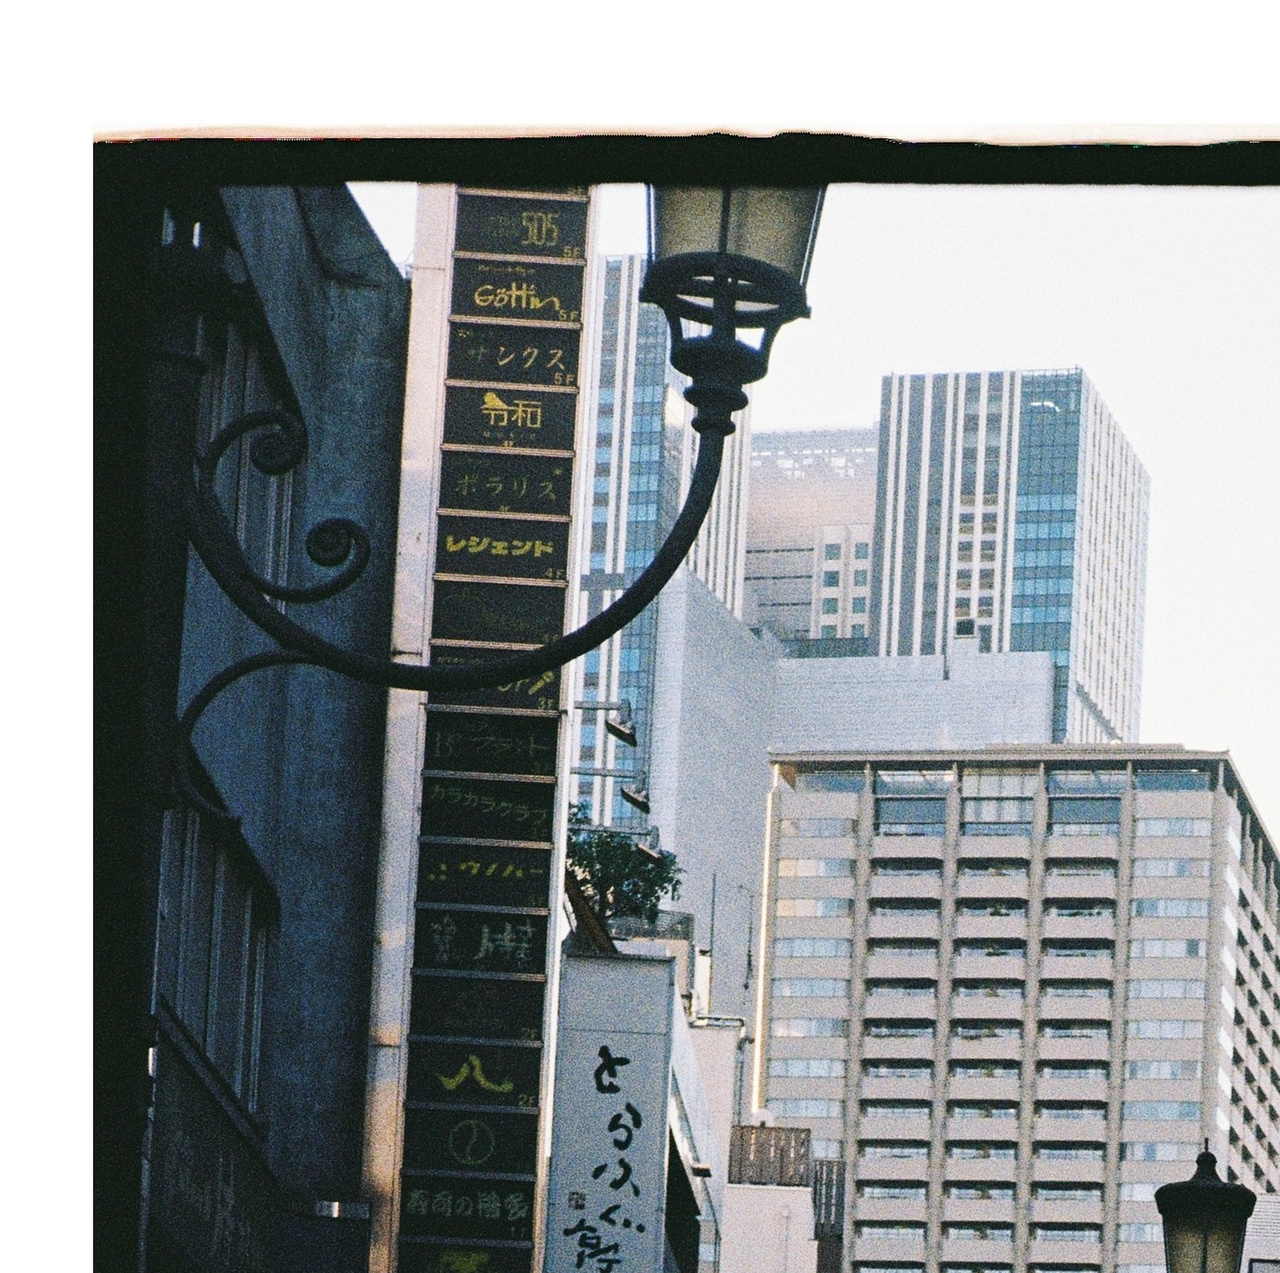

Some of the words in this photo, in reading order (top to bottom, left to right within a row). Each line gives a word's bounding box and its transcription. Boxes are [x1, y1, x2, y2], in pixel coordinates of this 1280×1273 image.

[445, 535, 554, 558] レジェンド
